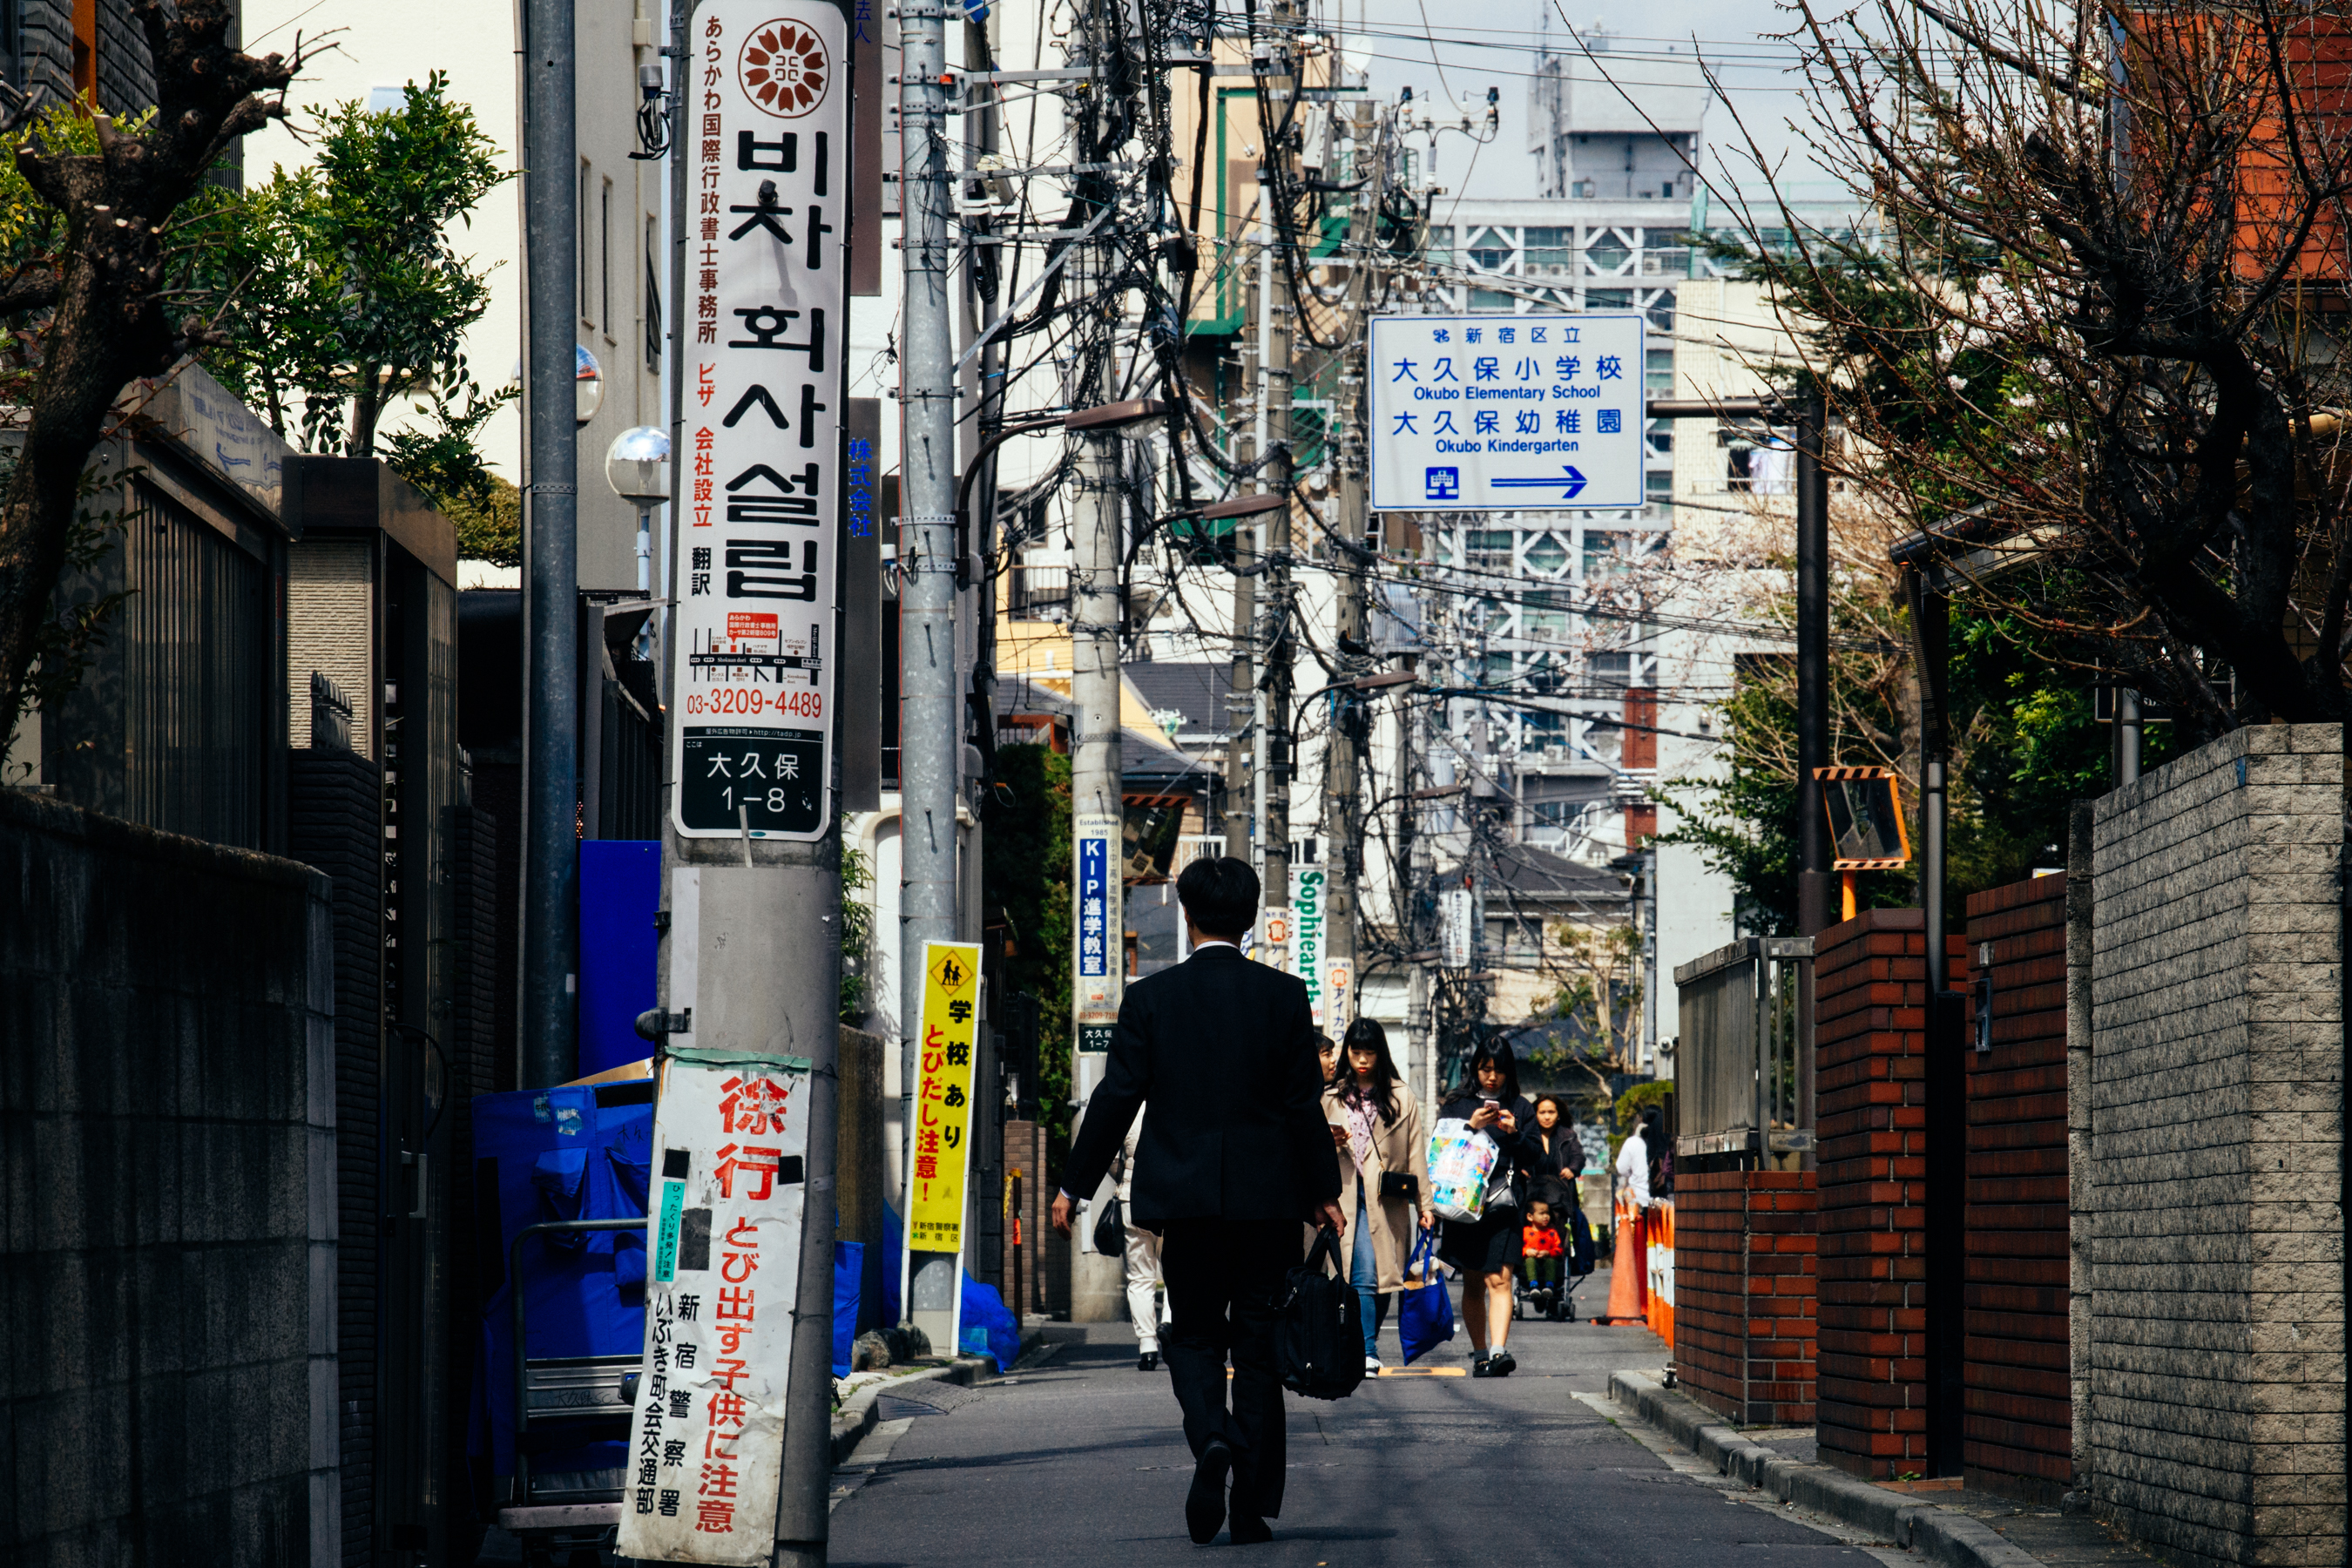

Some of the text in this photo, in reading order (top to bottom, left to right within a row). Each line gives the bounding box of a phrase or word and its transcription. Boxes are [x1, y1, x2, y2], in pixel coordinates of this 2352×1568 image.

[691, 15, 722, 597] あらかわ国際行政書士事務所 ビザ 会社設立 翻訳
[1465, 327, 1581, 344] 新宿区立
[1392, 355, 1623, 382] 大久保小学校
[1414, 385, 1600, 401] Okubo Elementary School
[1393, 409, 1621, 436] 大久保幼稚園
[1436, 439, 1578, 454] Okubo Kindergarten
[848, 437, 872, 537] 株式会社
[687, 688, 821, 718] 03-3209-4489
[707, 753, 799, 780] 大久保
[1083, 841, 1102, 974] KIP進学教室
[1334, 989, 1345, 1042] アイカワ
[1085, 1030, 1112, 1038] 大久保
[944, 1000, 971, 1149] 学校あり
[919, 1232, 958, 1242] 新宿区
[696, 1077, 788, 1533] 徐行 とび出す子供に注意
[636, 1292, 672, 1515] いぶき町会交通部
[658, 1294, 700, 1517] 新宿警察署
